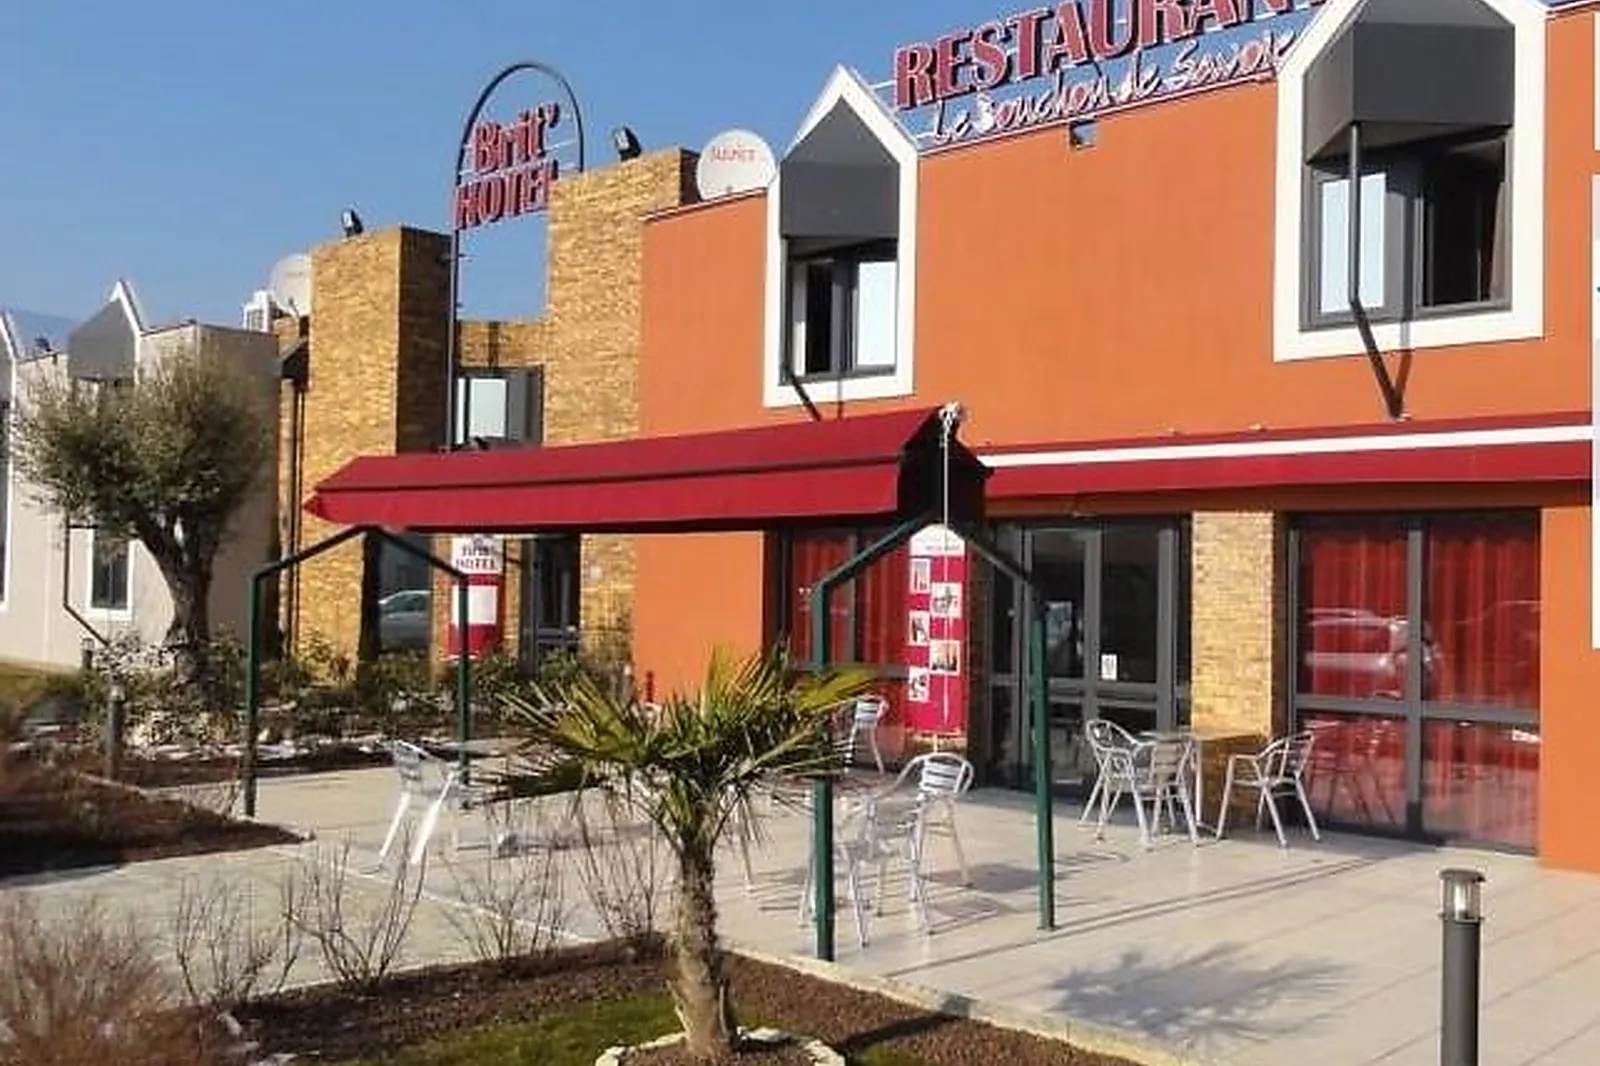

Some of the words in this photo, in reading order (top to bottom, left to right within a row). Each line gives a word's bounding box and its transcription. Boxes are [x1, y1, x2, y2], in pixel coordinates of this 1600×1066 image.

[894, 0, 1327, 111] RESTAURA
[932, 99, 974, 146] Le
[1117, 48, 1163, 103] de
